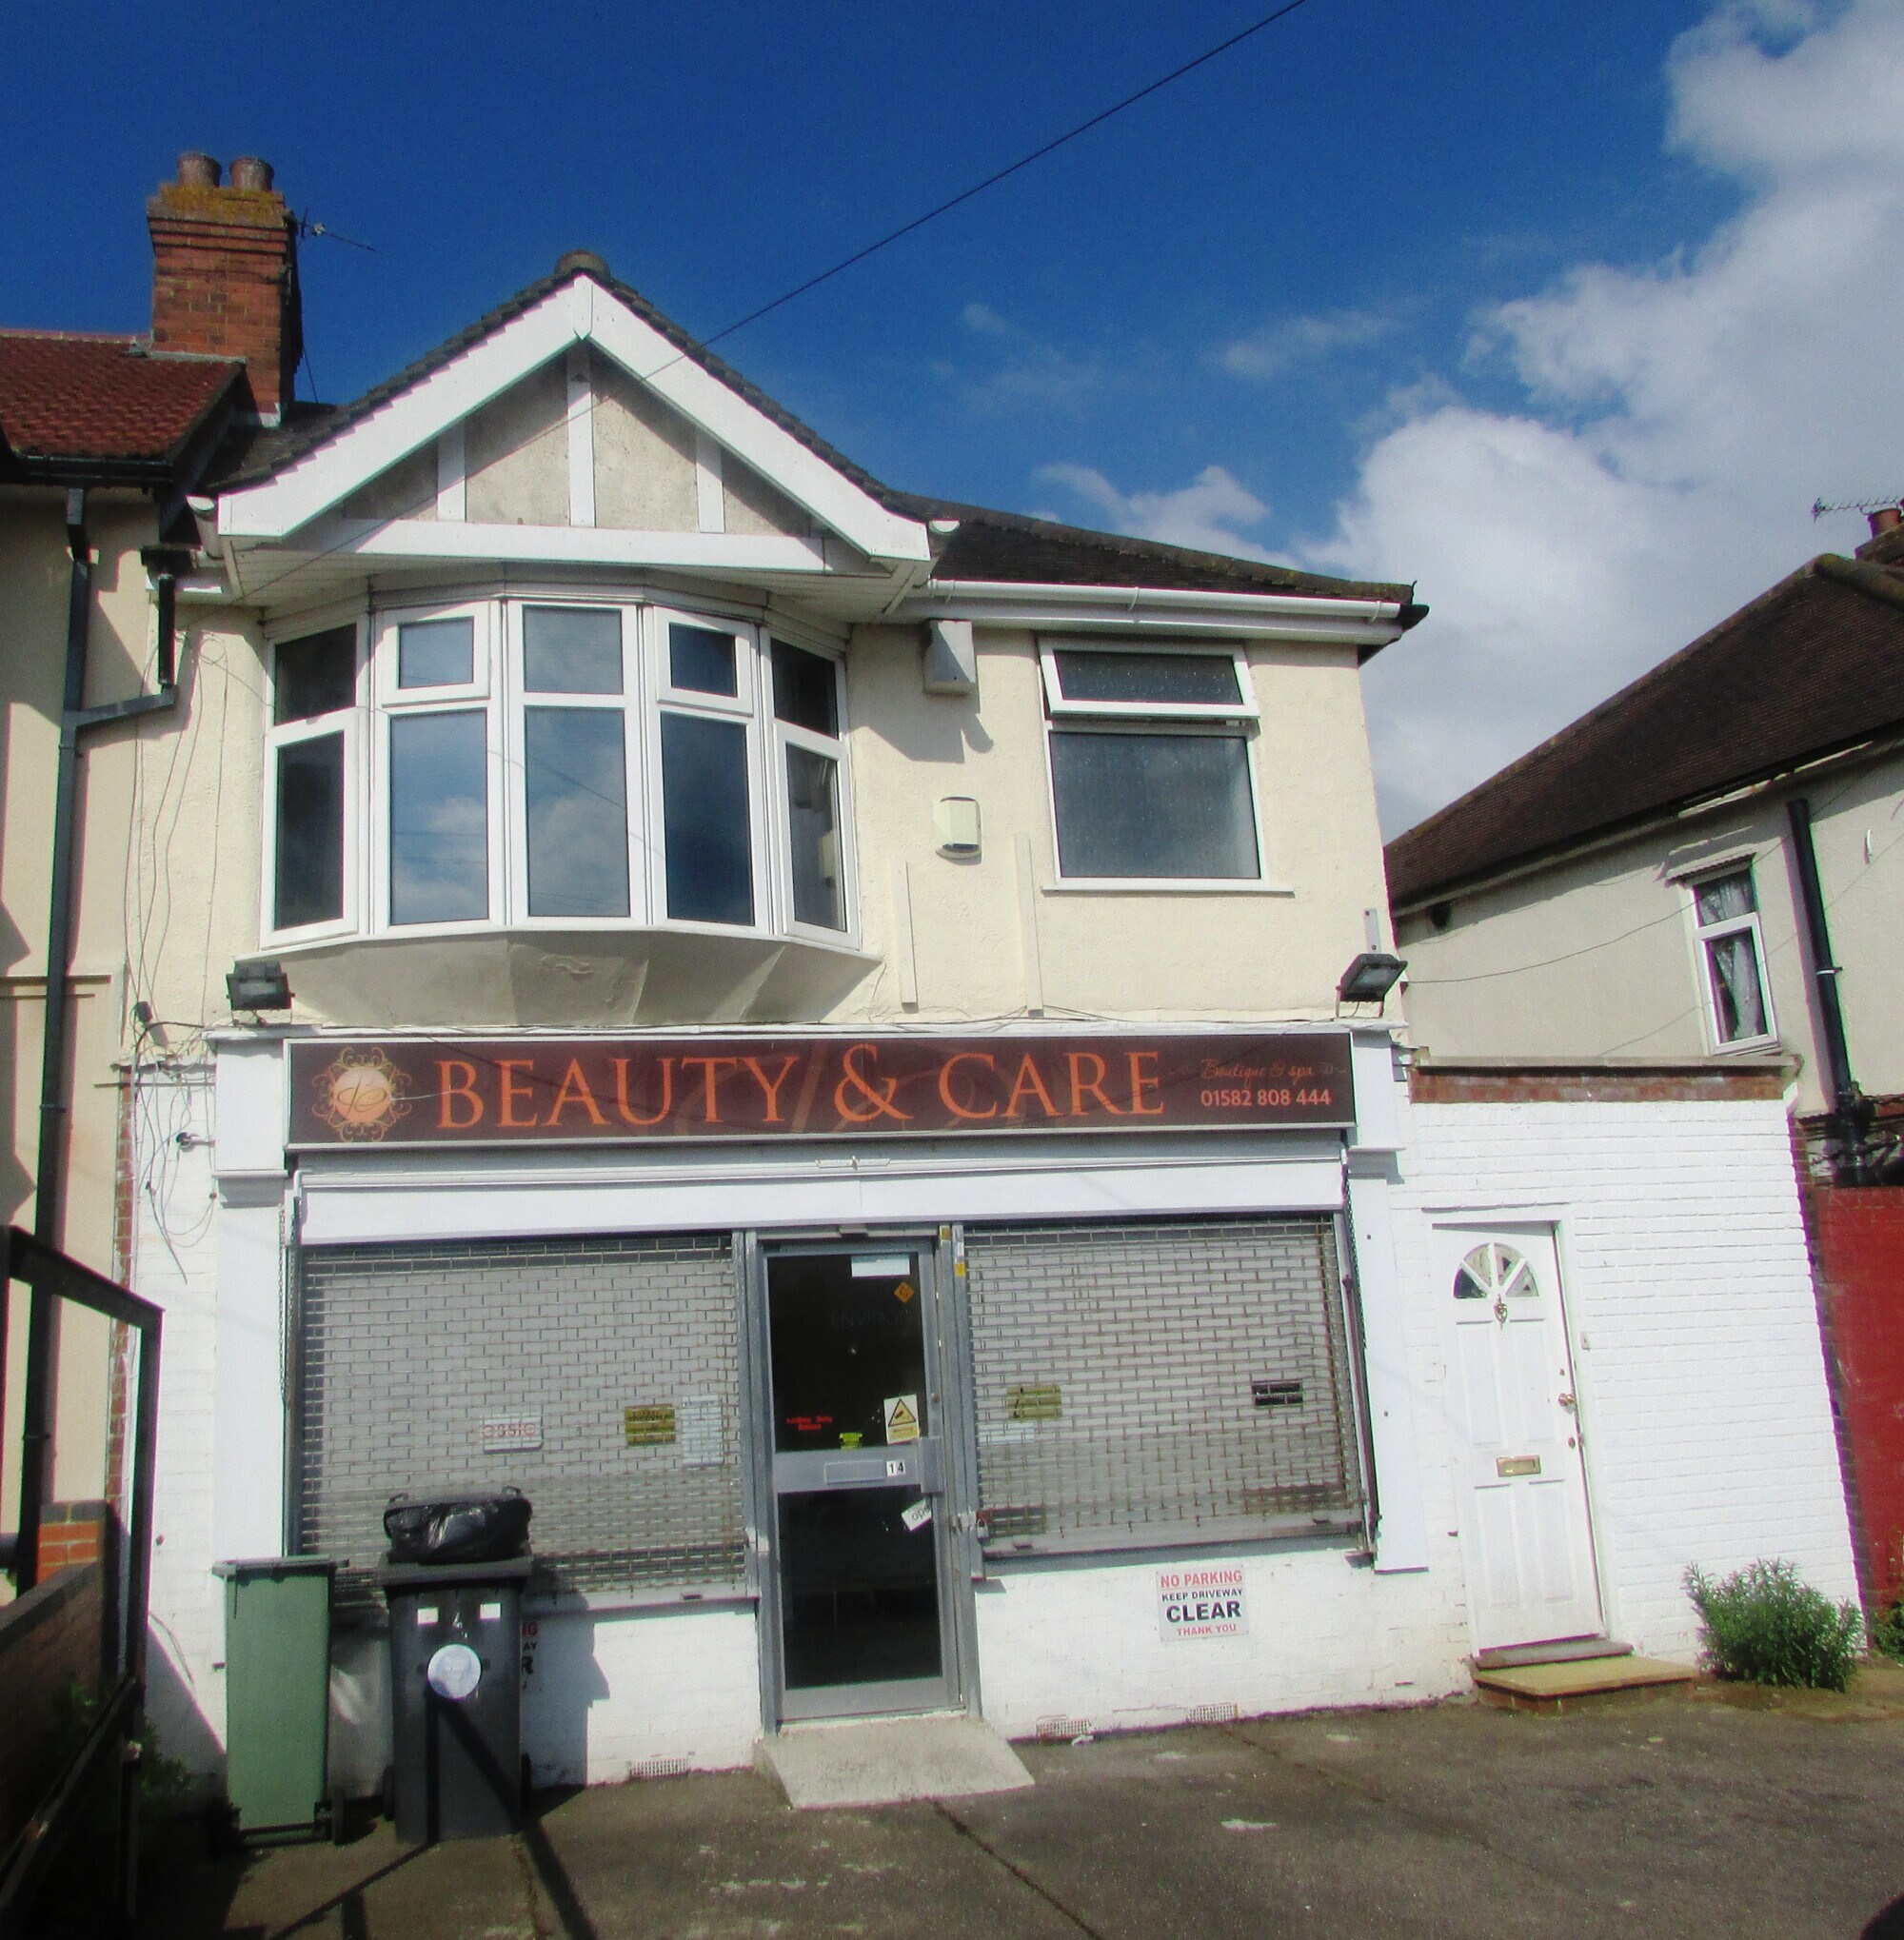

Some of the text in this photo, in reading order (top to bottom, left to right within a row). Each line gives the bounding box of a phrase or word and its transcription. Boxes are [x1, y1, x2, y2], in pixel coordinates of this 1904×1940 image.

[434, 1055, 803, 1130] BEAUTY
[833, 1043, 915, 1121] &
[938, 1050, 1166, 1120] CARE
[1200, 1088, 1332, 1106] 01582 808 444
[888, 1461, 904, 1475] 14
[1160, 1569, 1243, 1588] NO PARKING
[1161, 1588, 1243, 1602] KEEP DRIVEWAY
[1166, 1600, 1241, 1623] CLEAR
[1177, 1623, 1237, 1636] THANK YOU
